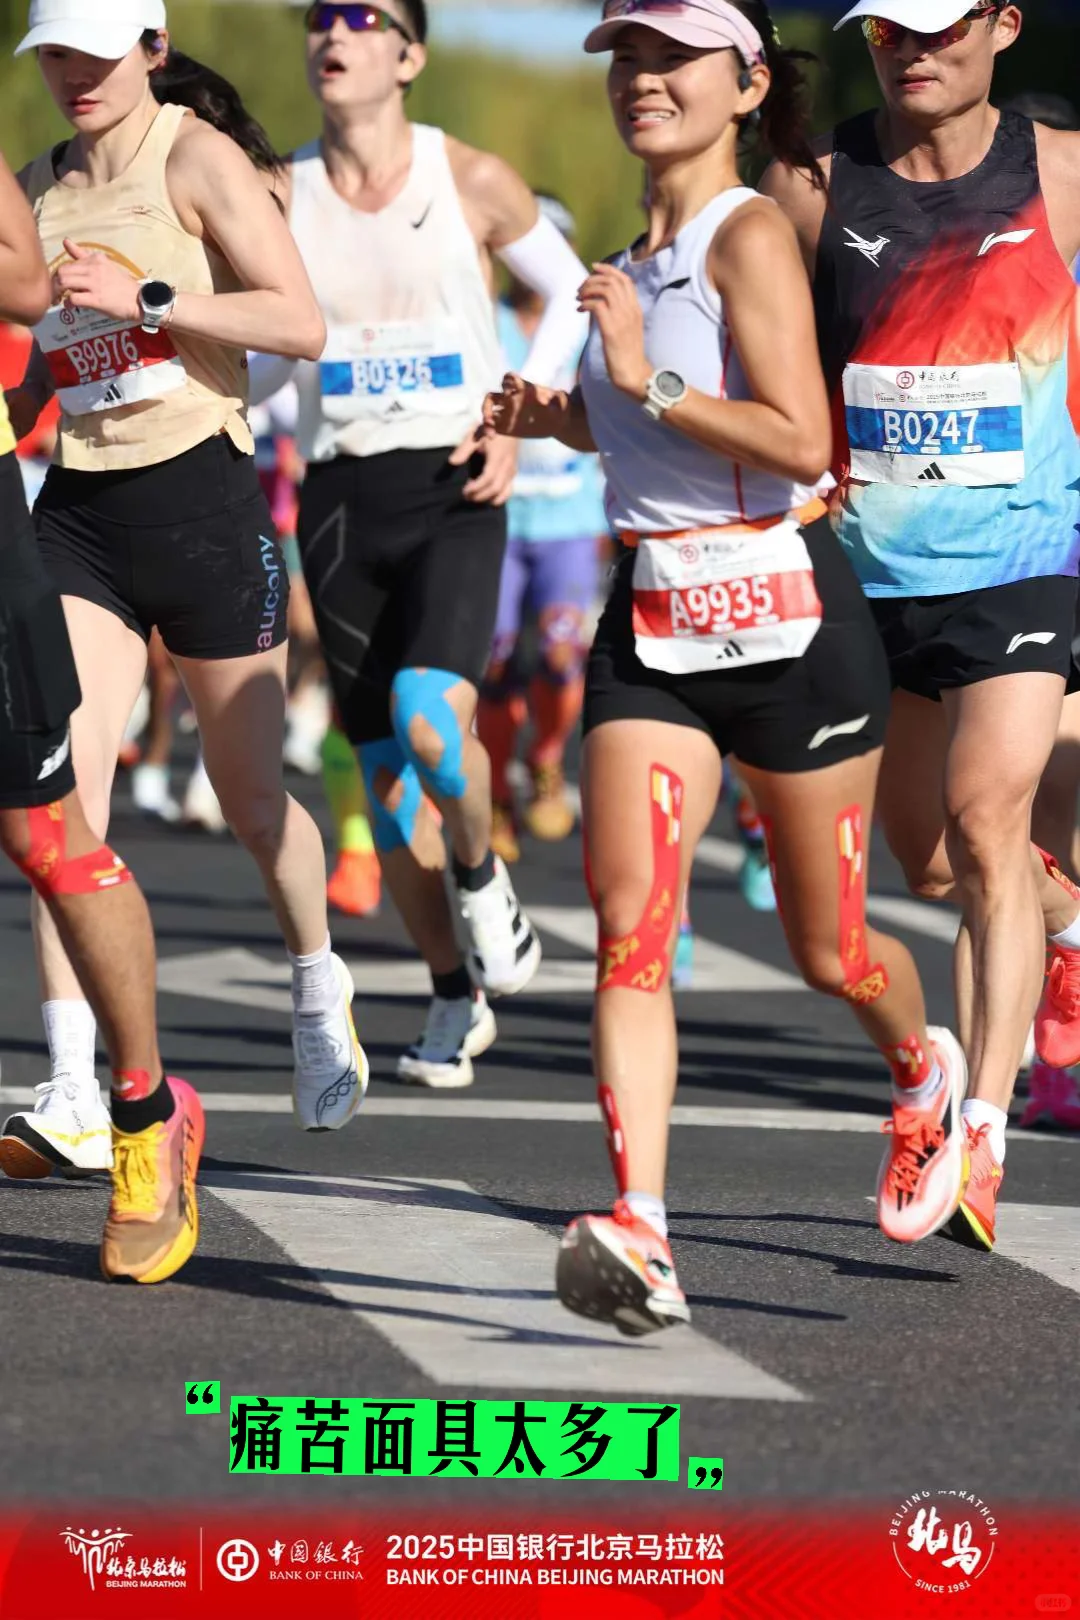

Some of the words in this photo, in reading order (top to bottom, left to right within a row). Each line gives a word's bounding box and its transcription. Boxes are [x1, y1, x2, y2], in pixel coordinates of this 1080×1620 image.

[66, 331, 138, 375] B9976
[353, 359, 432, 390] B0326
[884, 410, 979, 445] B0247
[257, 534, 279, 654] aucony
[670, 575, 773, 630] A9935
